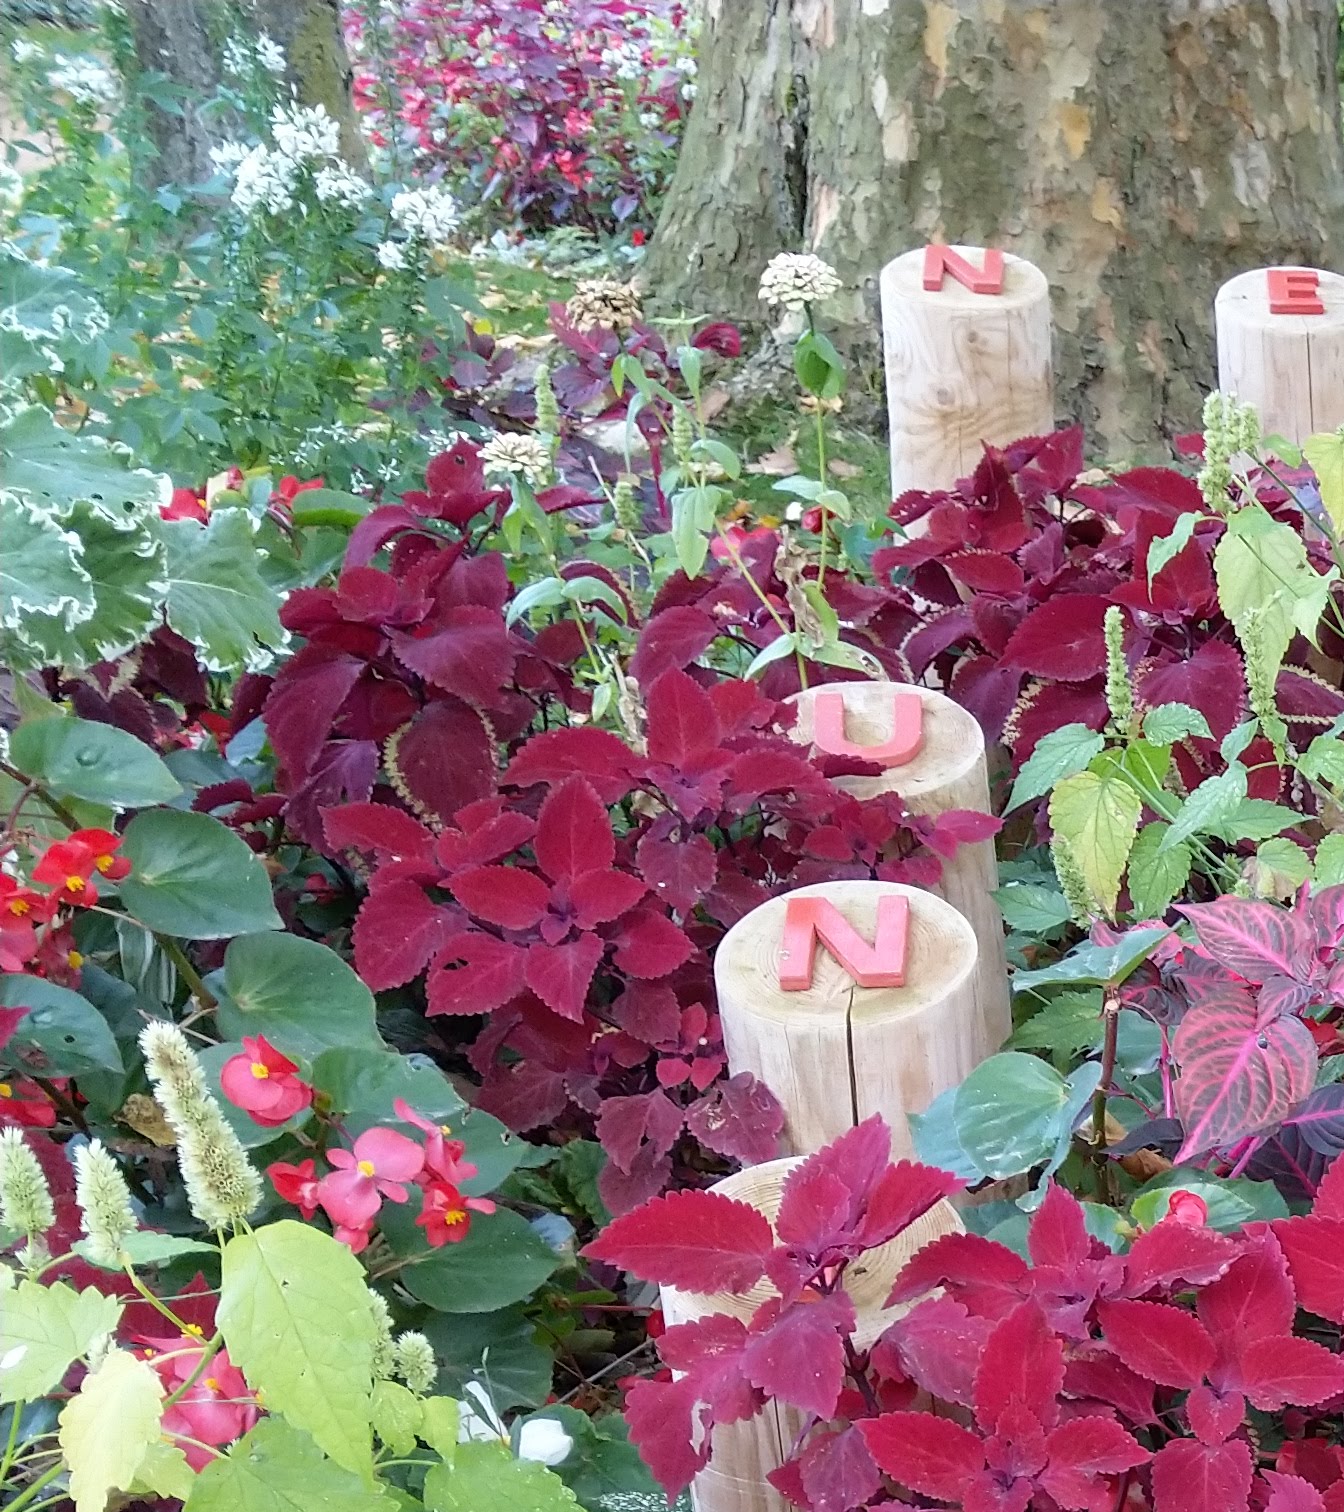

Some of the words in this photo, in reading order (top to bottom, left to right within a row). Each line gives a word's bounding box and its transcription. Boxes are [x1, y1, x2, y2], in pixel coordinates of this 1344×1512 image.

[922, 244, 1004, 295] N
[1267, 269, 1324, 315] E
[813, 694, 922, 767] U
[779, 895, 910, 991] N
